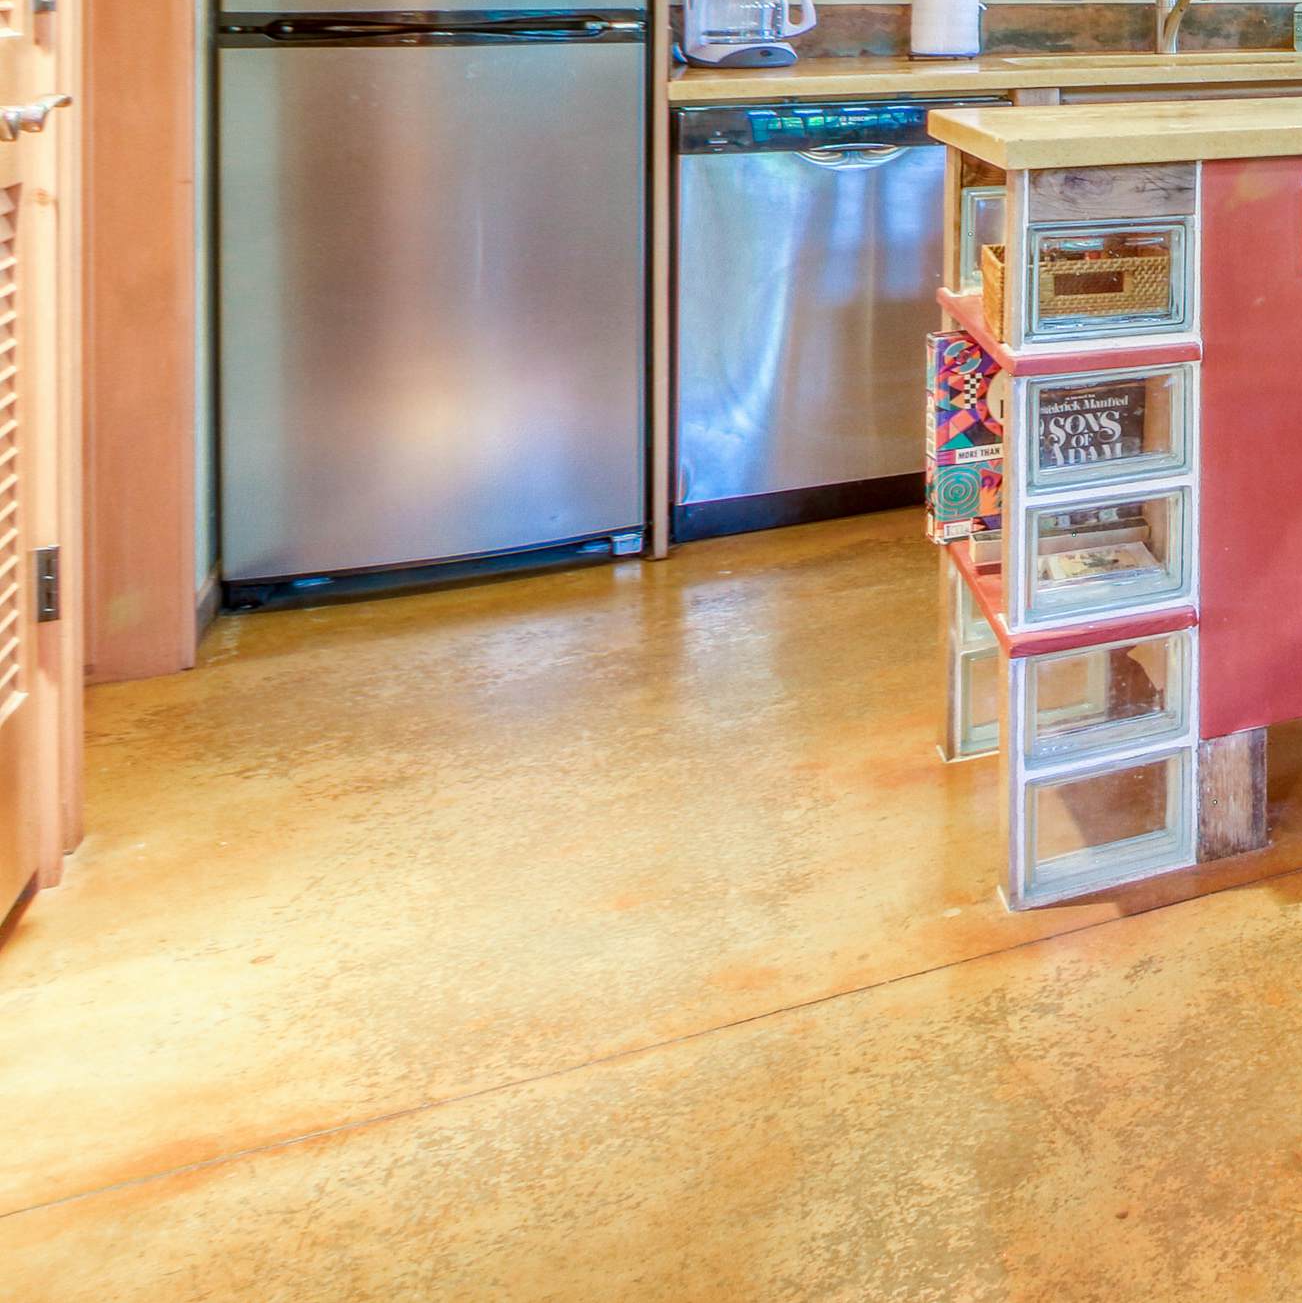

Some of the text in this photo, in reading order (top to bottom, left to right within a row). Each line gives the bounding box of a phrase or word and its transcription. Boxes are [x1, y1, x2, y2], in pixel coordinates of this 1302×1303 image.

[1082, 395, 1129, 410] Manfred
[1048, 411, 1122, 449] SONS
[1071, 434, 1093, 449] OF
[958, 447, 1000, 459] MORE THAN
[1051, 442, 1122, 466] ADAM
